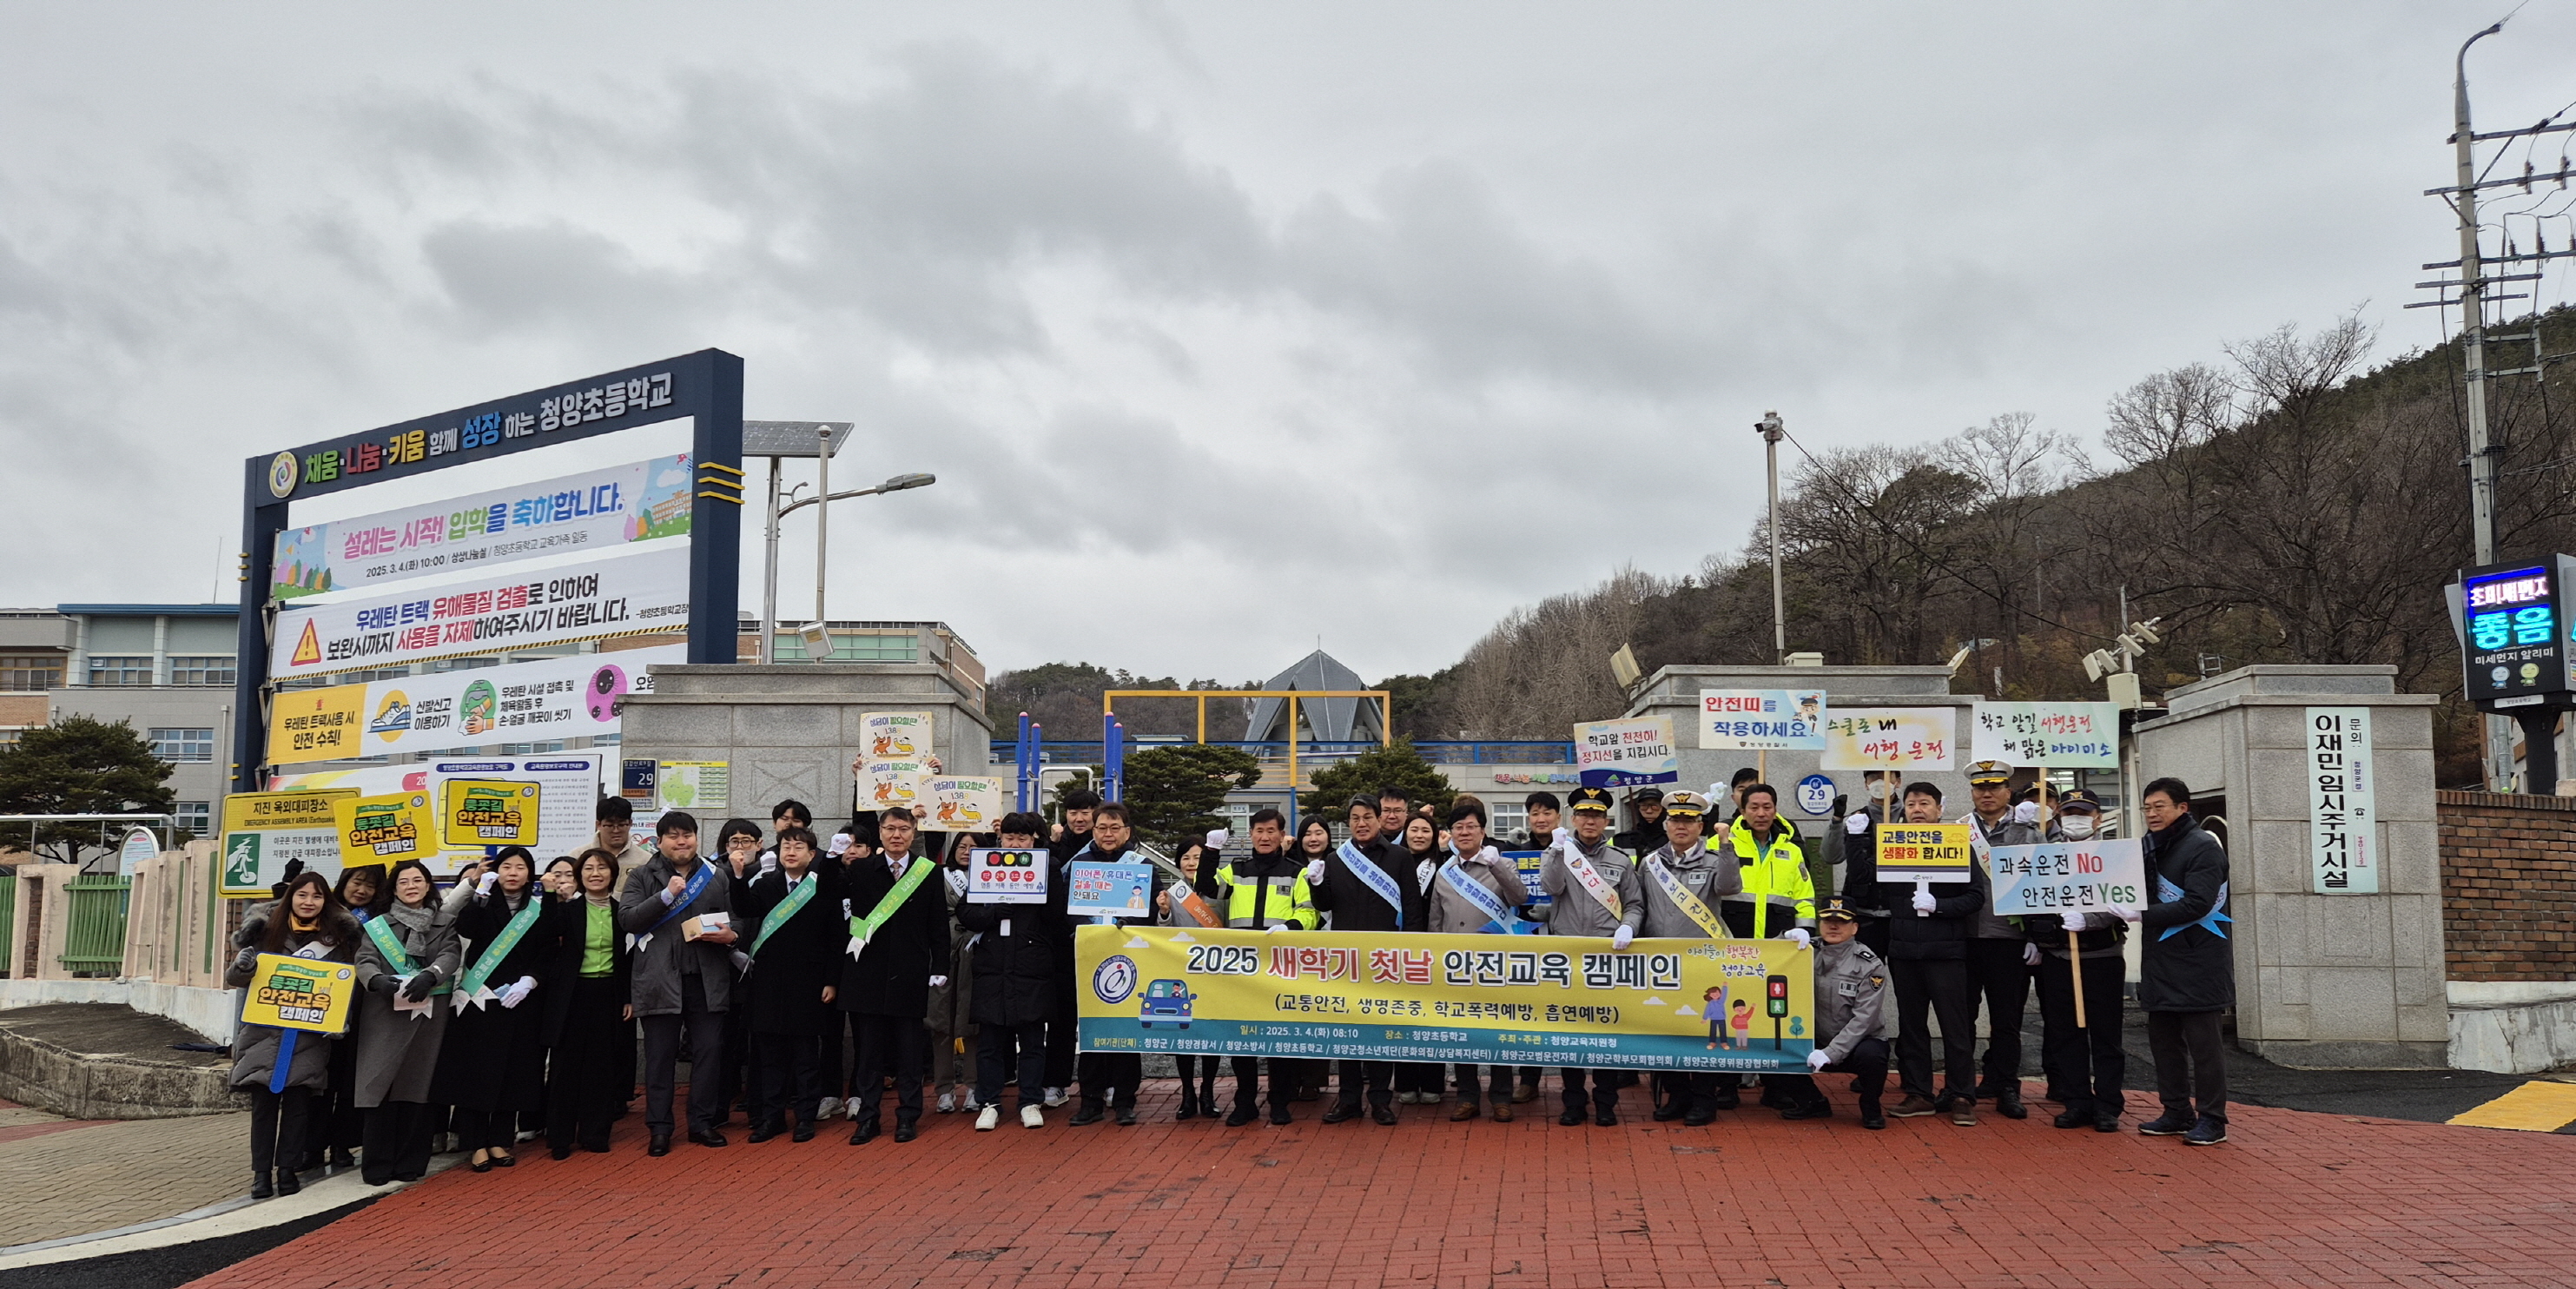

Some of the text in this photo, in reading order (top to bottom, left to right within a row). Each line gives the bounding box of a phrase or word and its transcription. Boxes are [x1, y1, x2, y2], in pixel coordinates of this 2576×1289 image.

[429, 428, 457, 456] 함께
[462, 411, 500, 449] 성장
[505, 412, 535, 439] 하는
[540, 372, 672, 431] 청양초등학교
[344, 482, 624, 559] 설레는 시작! 입학을 축하합니다.
[366, 564, 389, 578] 2025.
[420, 555, 445, 568] 10:00
[493, 539, 538, 557] 청양초등학교
[539, 534, 571, 550] 교육가족
[571, 531, 588, 543] 일동
[356, 572, 598, 631] 우레탄 트랙 유해물질 검출로 인하여
[327, 631, 394, 661] 보완시까지
[396, 624, 440, 650] 사용을
[442, 607, 553, 644] 자제하여주시기
[557, 597, 630, 629] 바랍니다.
[2472, 606, 2553, 650] 좋음
[2475, 651, 2517, 665] 미세먼지
[2520, 647, 2553, 659] 알리미
[501, 686, 526, 698] 우레탄
[528, 683, 545, 696] 시설
[565, 679, 574, 692] 및
[416, 697, 452, 715] 신발신고
[500, 697, 543, 712] 체육활동 후
[1706, 697, 1777, 712] 안전띠를
[284, 711, 354, 731] 우레탄 트랙사용 시
[414, 714, 451, 730] 이용하기
[526, 711, 552, 724] 깨끗이
[554, 708, 571, 723] 씻기
[870, 717, 889, 727] 상담이
[1878, 718, 1897, 731] 내
[1980, 711, 2005, 731] 학교
[294, 729, 340, 750] 안전 수칙!
[1588, 729, 1657, 747] 학교앞 천천히!
[1582, 744, 1671, 763] 정지선을 지킵시다.
[870, 763, 890, 774] 상담이
[637, 773, 654, 785] 29
[934, 781, 956, 792] 상담이
[1495, 773, 1510, 783] 채움
[1513, 773, 1529, 783] 나눔
[1808, 790, 1826, 800] 29
[2315, 715, 2348, 889] 이재민임시주거시설
[253, 799, 328, 815] 지진 옥외대피장소
[465, 797, 504, 812] 등굣길
[244, 818, 270, 827] EMERGENCY
[271, 817, 295, 826] ASSEMBLY
[354, 814, 395, 830] 등굣길
[457, 810, 522, 827] 안전교육
[349, 823, 416, 847] 안전교육
[478, 825, 518, 838] 캠페인
[1882, 830, 1944, 844] 교통안전을
[273, 836, 290, 845] 이곳은
[292, 836, 304, 845] 지진
[305, 836, 323, 844] 발생에
[374, 840, 415, 856] 캠페인
[273, 849, 290, 858] 지정된
[291, 849, 304, 858] 긴급
[1882, 846, 1964, 860] 생활화 합시다!
[1999, 853, 2104, 877] 과속운전 No
[1074, 869, 1133, 880] 이어폰/휴대폰
[1073, 880, 1113, 891] 걸을 때는
[1073, 891, 1100, 901] 안돼요
[2022, 884, 2094, 908] 안전운전
[2097, 882, 2137, 904] Yes
[1687, 943, 1760, 961] 아이들이 행복한
[1186, 945, 1679, 988] 2025 새학기 첫날 안전교육 캠페인
[1721, 962, 1767, 979] 청양교육
[269, 975, 314, 993] 등굣길
[258, 987, 331, 1011] 안전교육
[279, 1006, 325, 1023] 캠페인
[1275, 994, 1620, 1024] (교통안전, 생명존중, 학교폭력예방, 흡연예방)
[1239, 1024, 1258, 1035] 일시
[1265, 1026, 1291, 1036] 2025.
[1332, 1028, 1358, 1038] 08:10
[1385, 1029, 1404, 1041] 장소
[1412, 1030, 1468, 1042] 청양초등학교
[1550, 1035, 1617, 1048] 청양교육지원청
[1093, 1037, 1137, 1049] 참여기관(단체)
[1144, 1038, 1168, 1050] 청양군
[1176, 1039, 1217, 1050] 청양경찰서
[1225, 1040, 1265, 1052] 청양소방서
[1274, 1041, 1323, 1054] 청양초등학교
[1501, 1049, 1577, 1063] 청양군모범운전자회
[1587, 1052, 1673, 1067] 청양군학부모회협의회
[1682, 1055, 1780, 1069] 청양군운영위원장협의회
